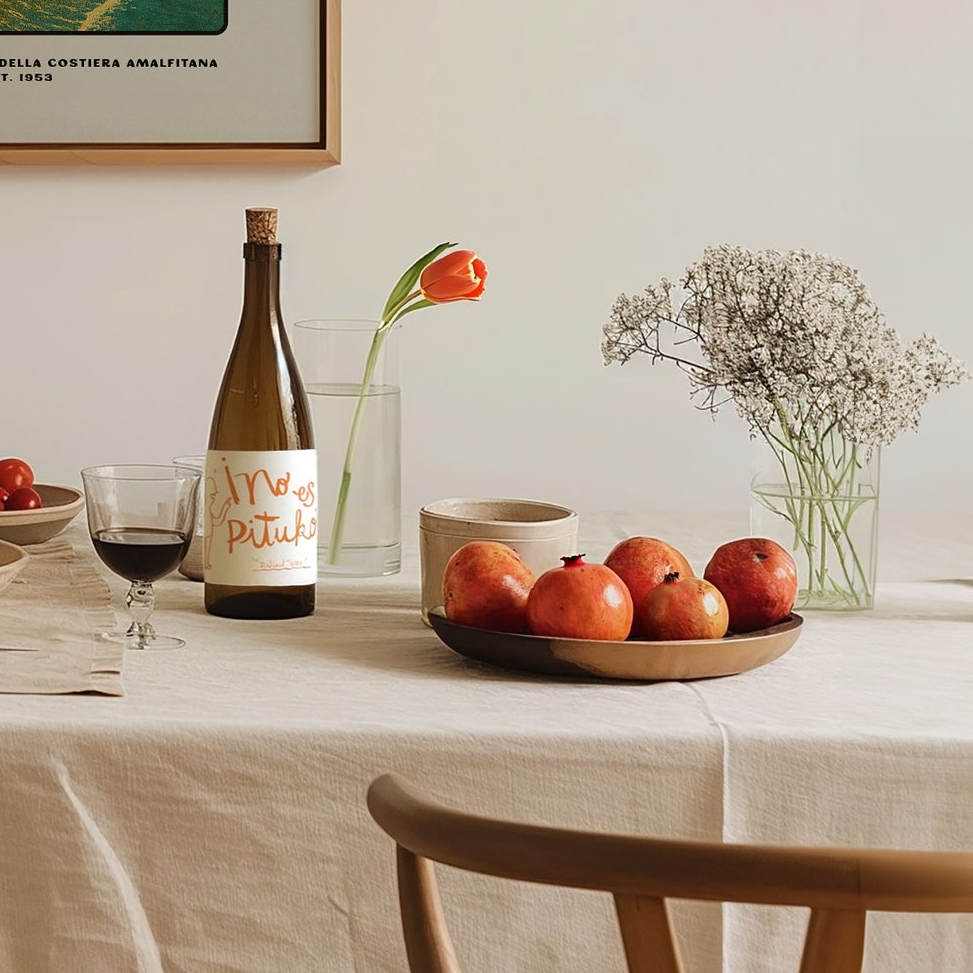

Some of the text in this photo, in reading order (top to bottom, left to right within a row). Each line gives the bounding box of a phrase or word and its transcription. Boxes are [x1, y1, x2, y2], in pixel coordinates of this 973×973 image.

[47, 58, 121, 68] COSTIERA
[126, 58, 218, 68] AMALFITANA
[19, 73, 53, 82] 1953
